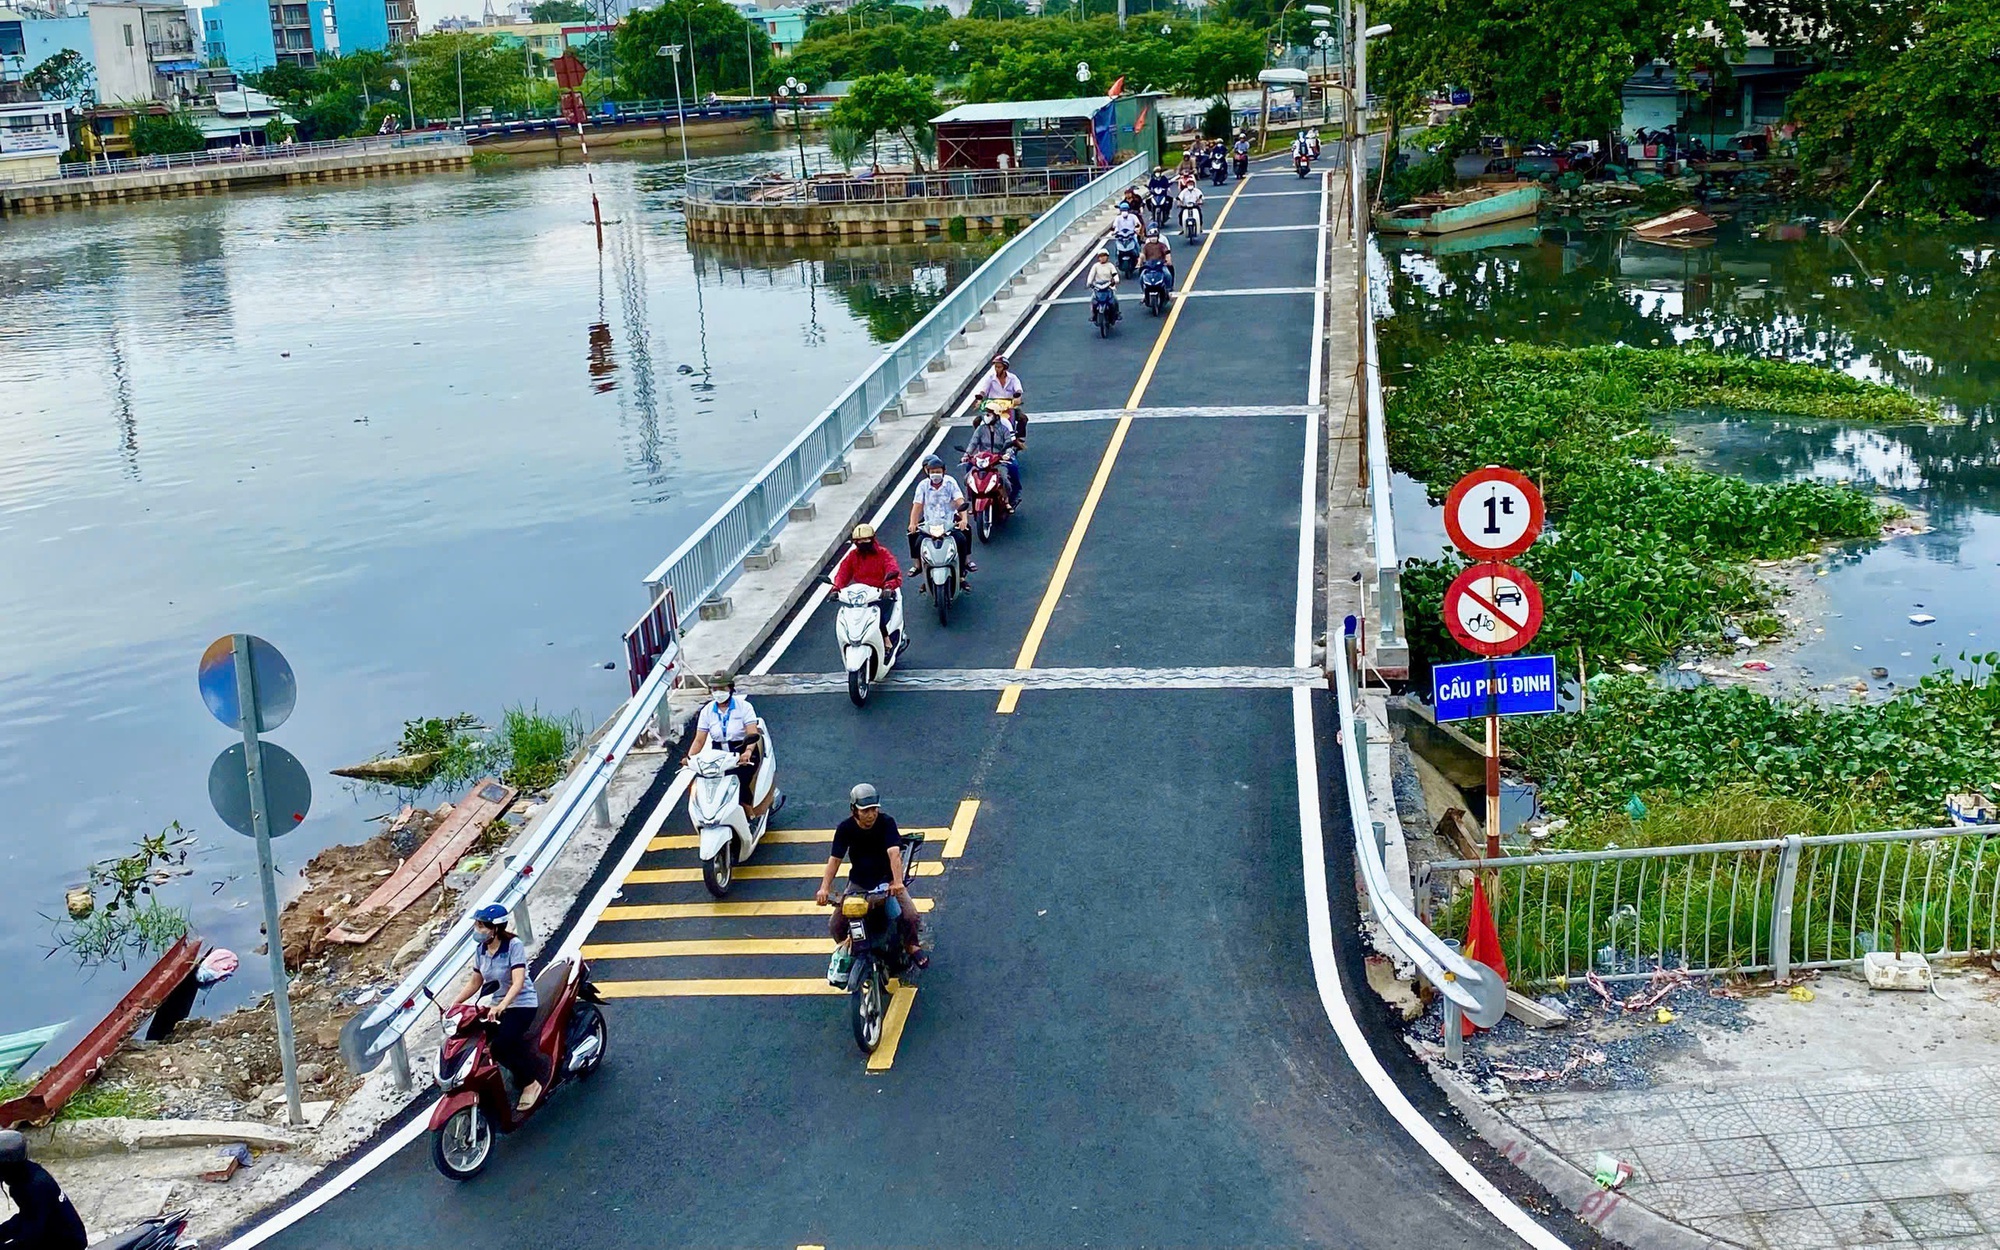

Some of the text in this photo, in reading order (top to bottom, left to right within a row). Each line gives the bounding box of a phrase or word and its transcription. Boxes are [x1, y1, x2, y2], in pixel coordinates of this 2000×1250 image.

[1440, 673, 1551, 701] CẦU PHÚ ĐỊNH
